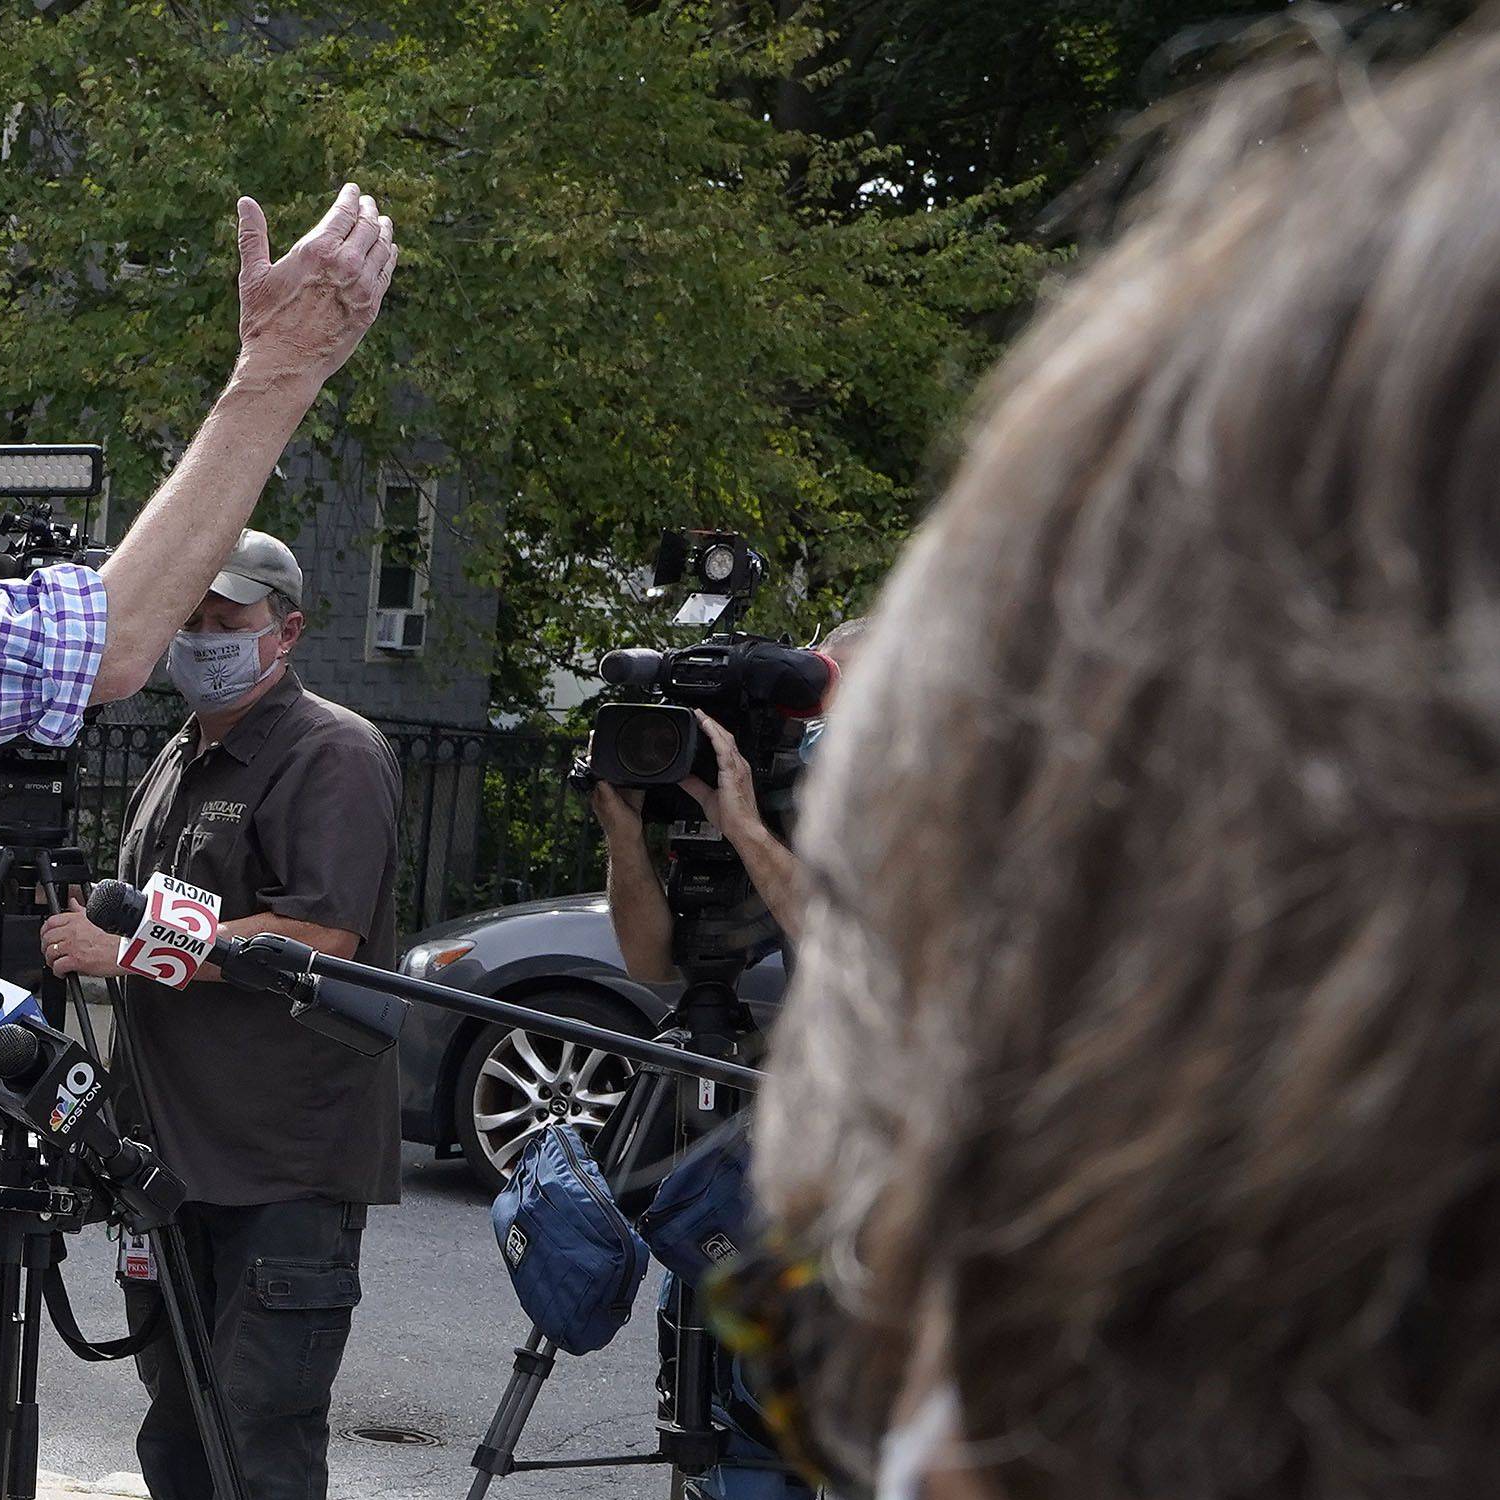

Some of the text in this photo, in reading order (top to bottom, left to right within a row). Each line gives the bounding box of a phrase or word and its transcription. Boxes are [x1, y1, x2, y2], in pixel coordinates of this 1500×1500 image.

[164, 877, 216, 907] WCVB
[149, 925, 206, 956] WCVB
[151, 890, 219, 946] 5
[119, 937, 199, 992] 5
[56, 1062, 95, 1104] 10
[61, 1082, 102, 1134] BOSTON
